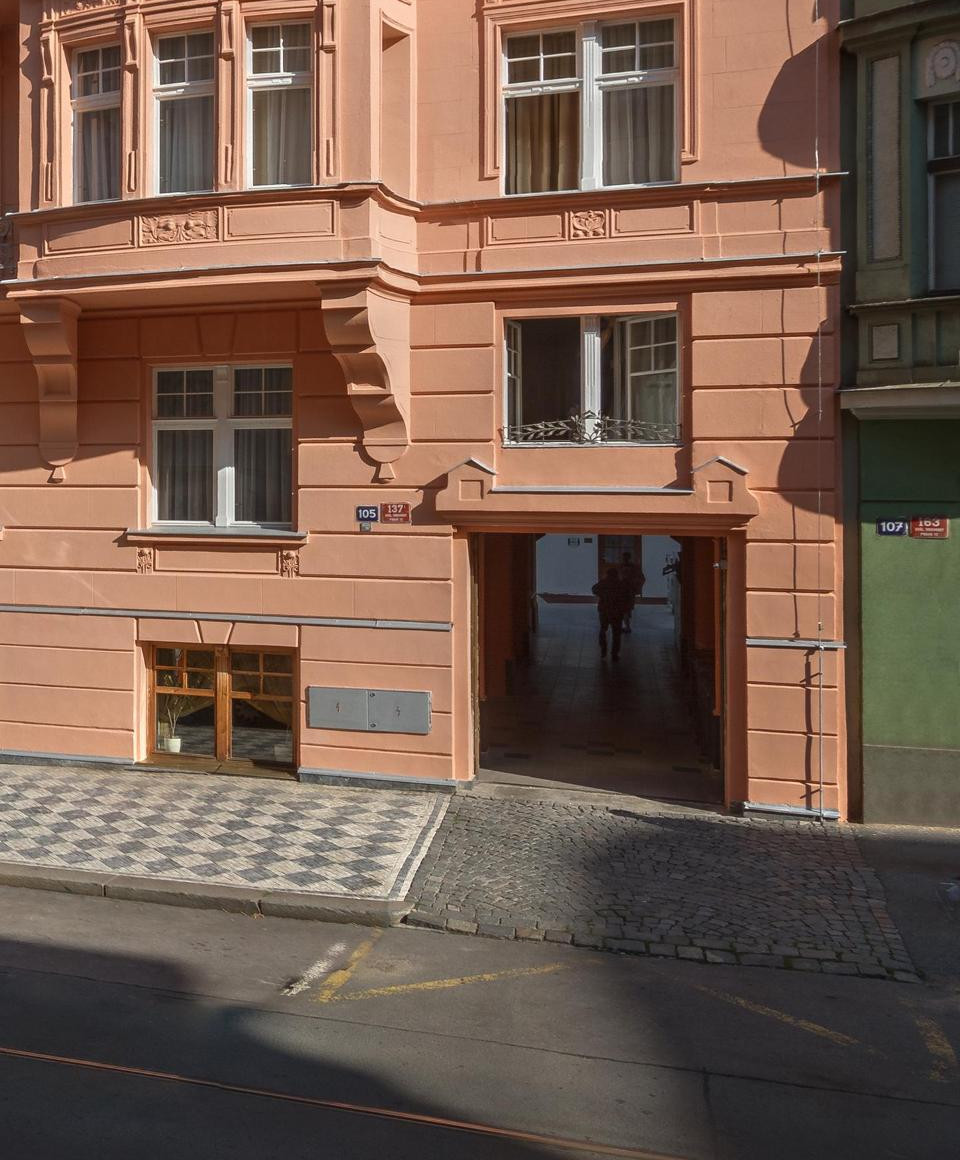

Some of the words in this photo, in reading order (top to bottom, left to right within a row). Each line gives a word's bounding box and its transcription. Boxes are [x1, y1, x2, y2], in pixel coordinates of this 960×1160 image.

[387, 504, 404, 513] 137
[358, 509, 377, 519] 105
[880, 521, 904, 532] 107
